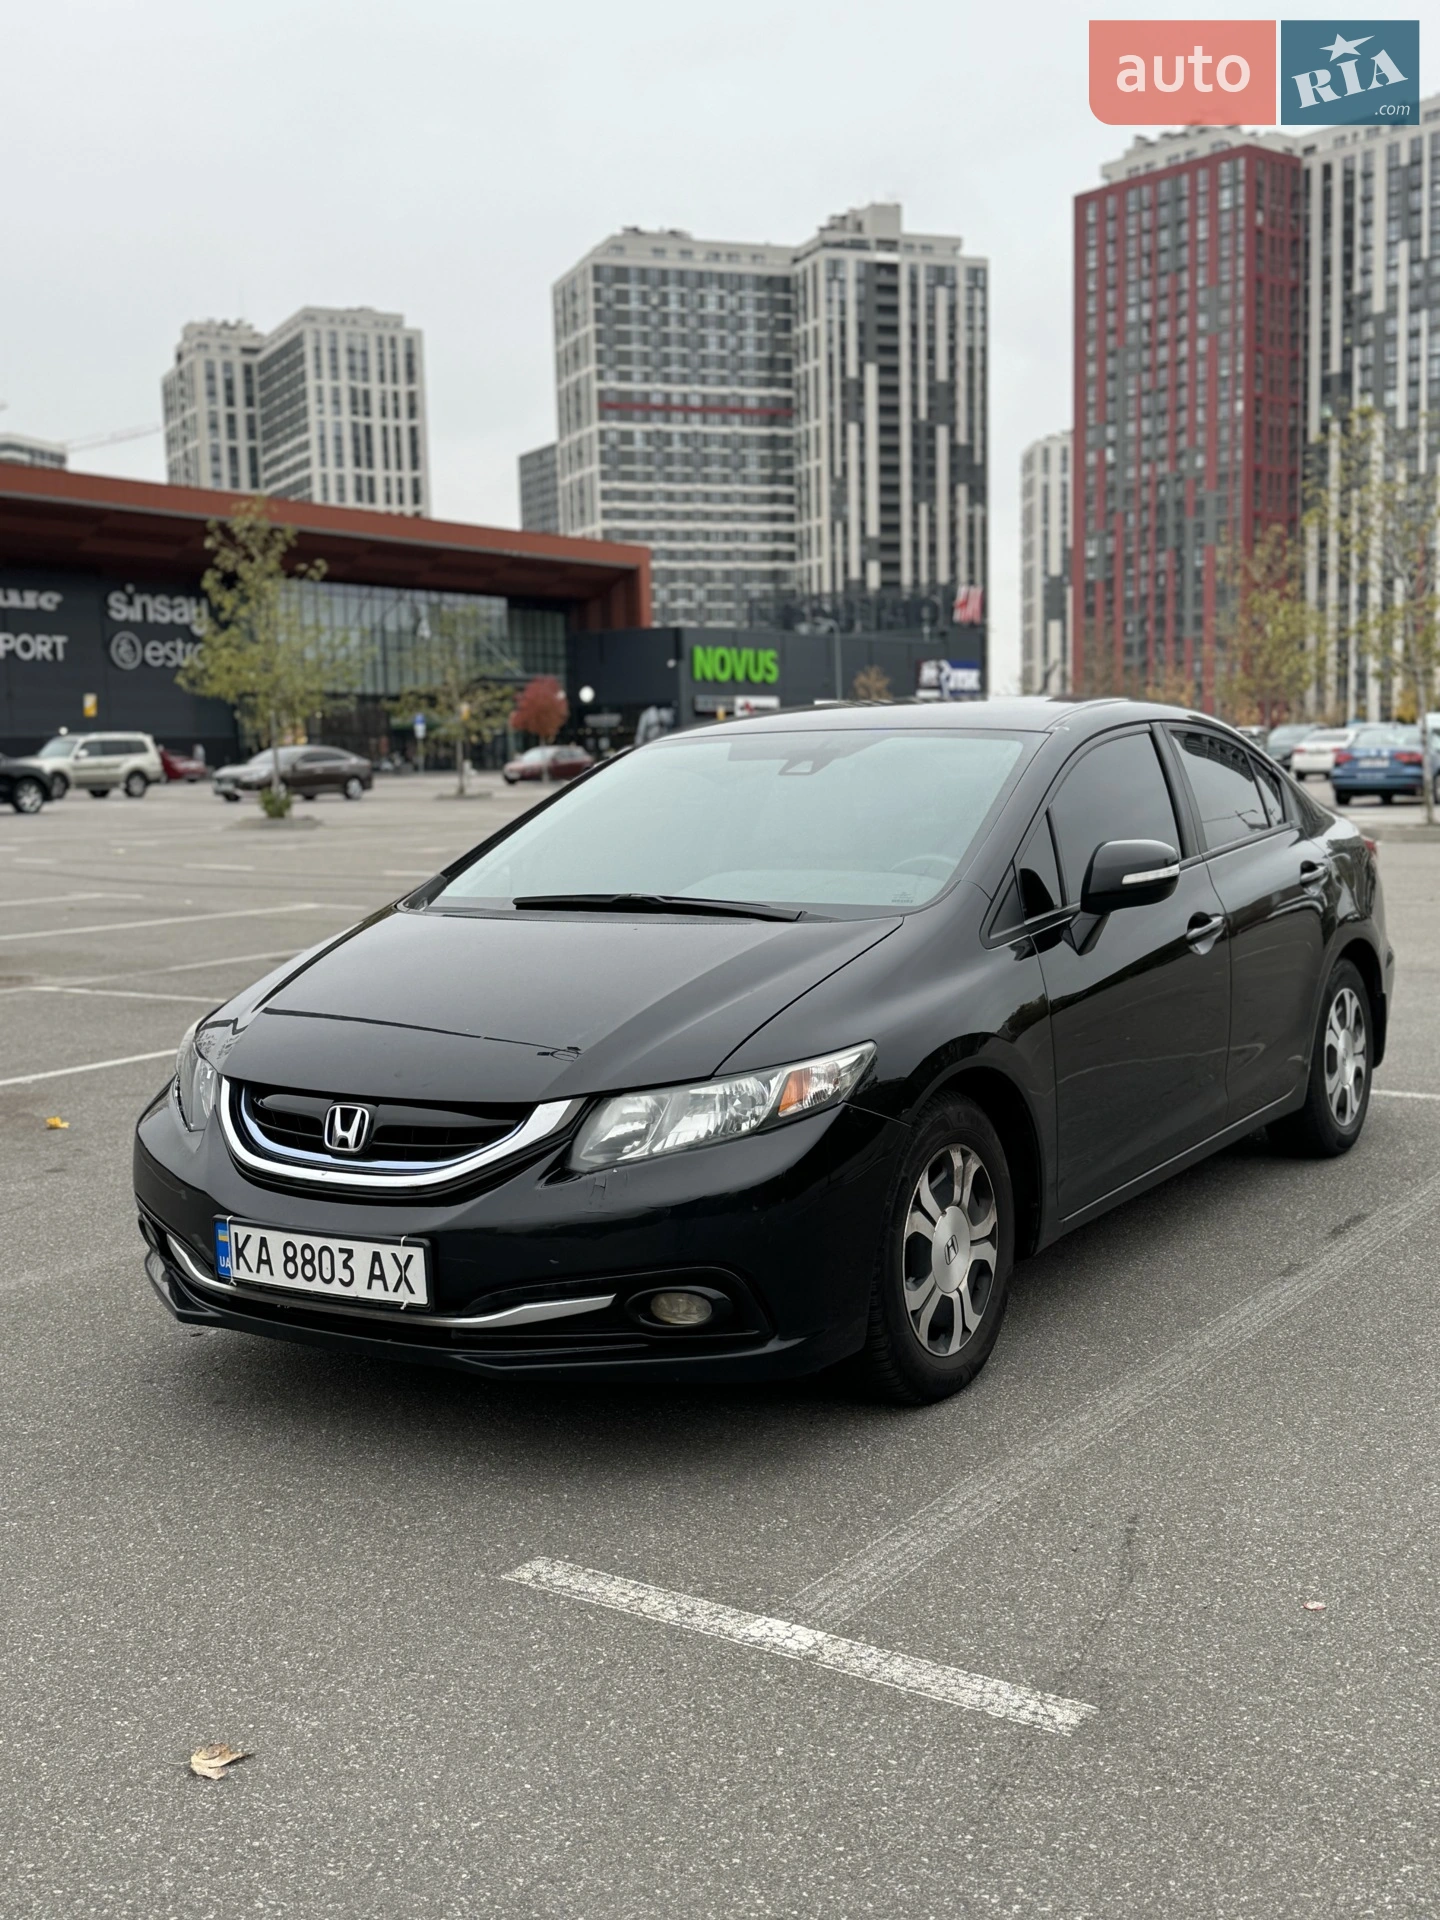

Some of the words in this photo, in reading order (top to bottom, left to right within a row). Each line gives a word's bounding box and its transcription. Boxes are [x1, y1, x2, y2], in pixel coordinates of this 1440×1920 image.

[692, 645, 779, 684] NOVUS
[219, 1255, 232, 1269] UA
[233, 1232, 275, 1276] KA
[282, 1241, 355, 1287] 8803
[367, 1251, 416, 1295] AX
